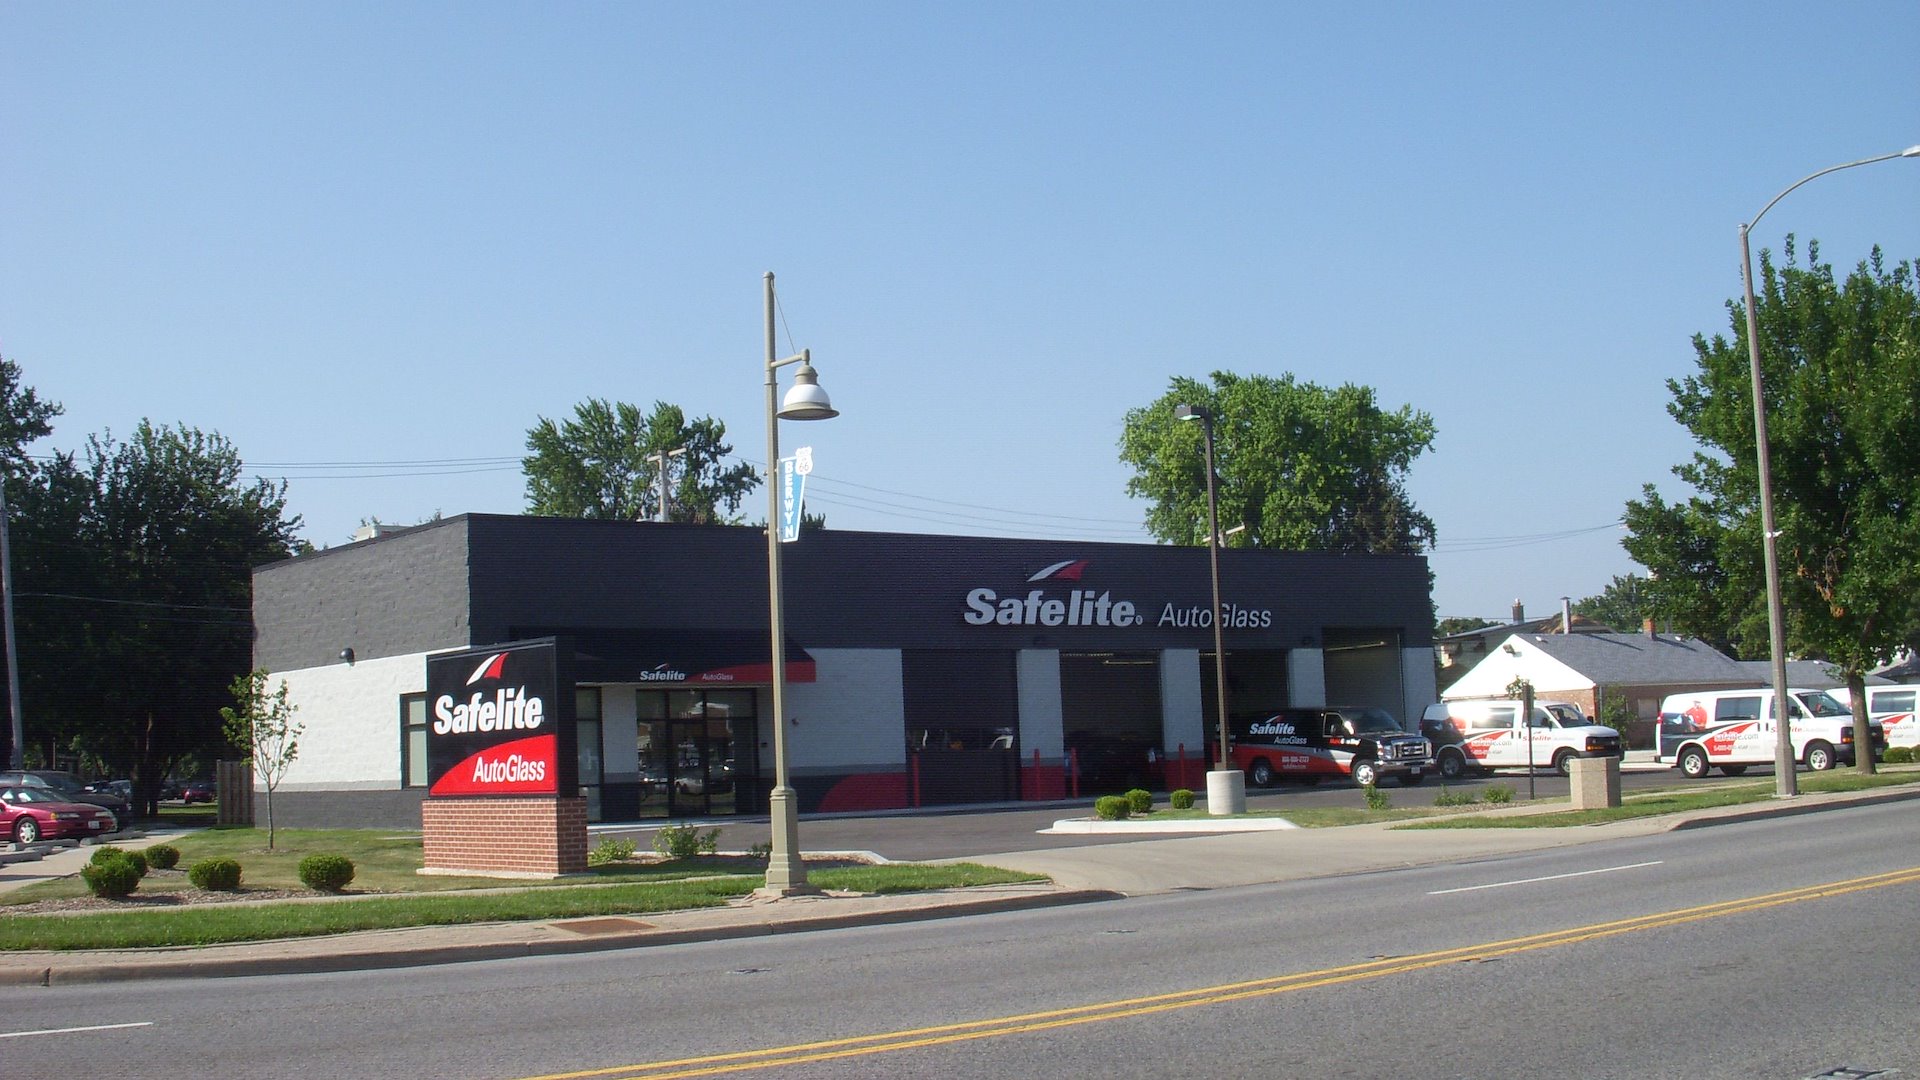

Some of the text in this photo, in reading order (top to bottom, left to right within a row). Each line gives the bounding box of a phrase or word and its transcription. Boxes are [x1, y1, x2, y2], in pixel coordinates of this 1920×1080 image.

[784, 461, 794, 538] BERWYN
[640, 670, 685, 681] Safelite
[701, 672, 734, 681] AutoGlass
[434, 685, 543, 735] Safelite
[1249, 723, 1295, 735] Safelite
[1273, 736, 1308, 745] AutoGlass
[472, 754, 546, 783] AutoGlass
